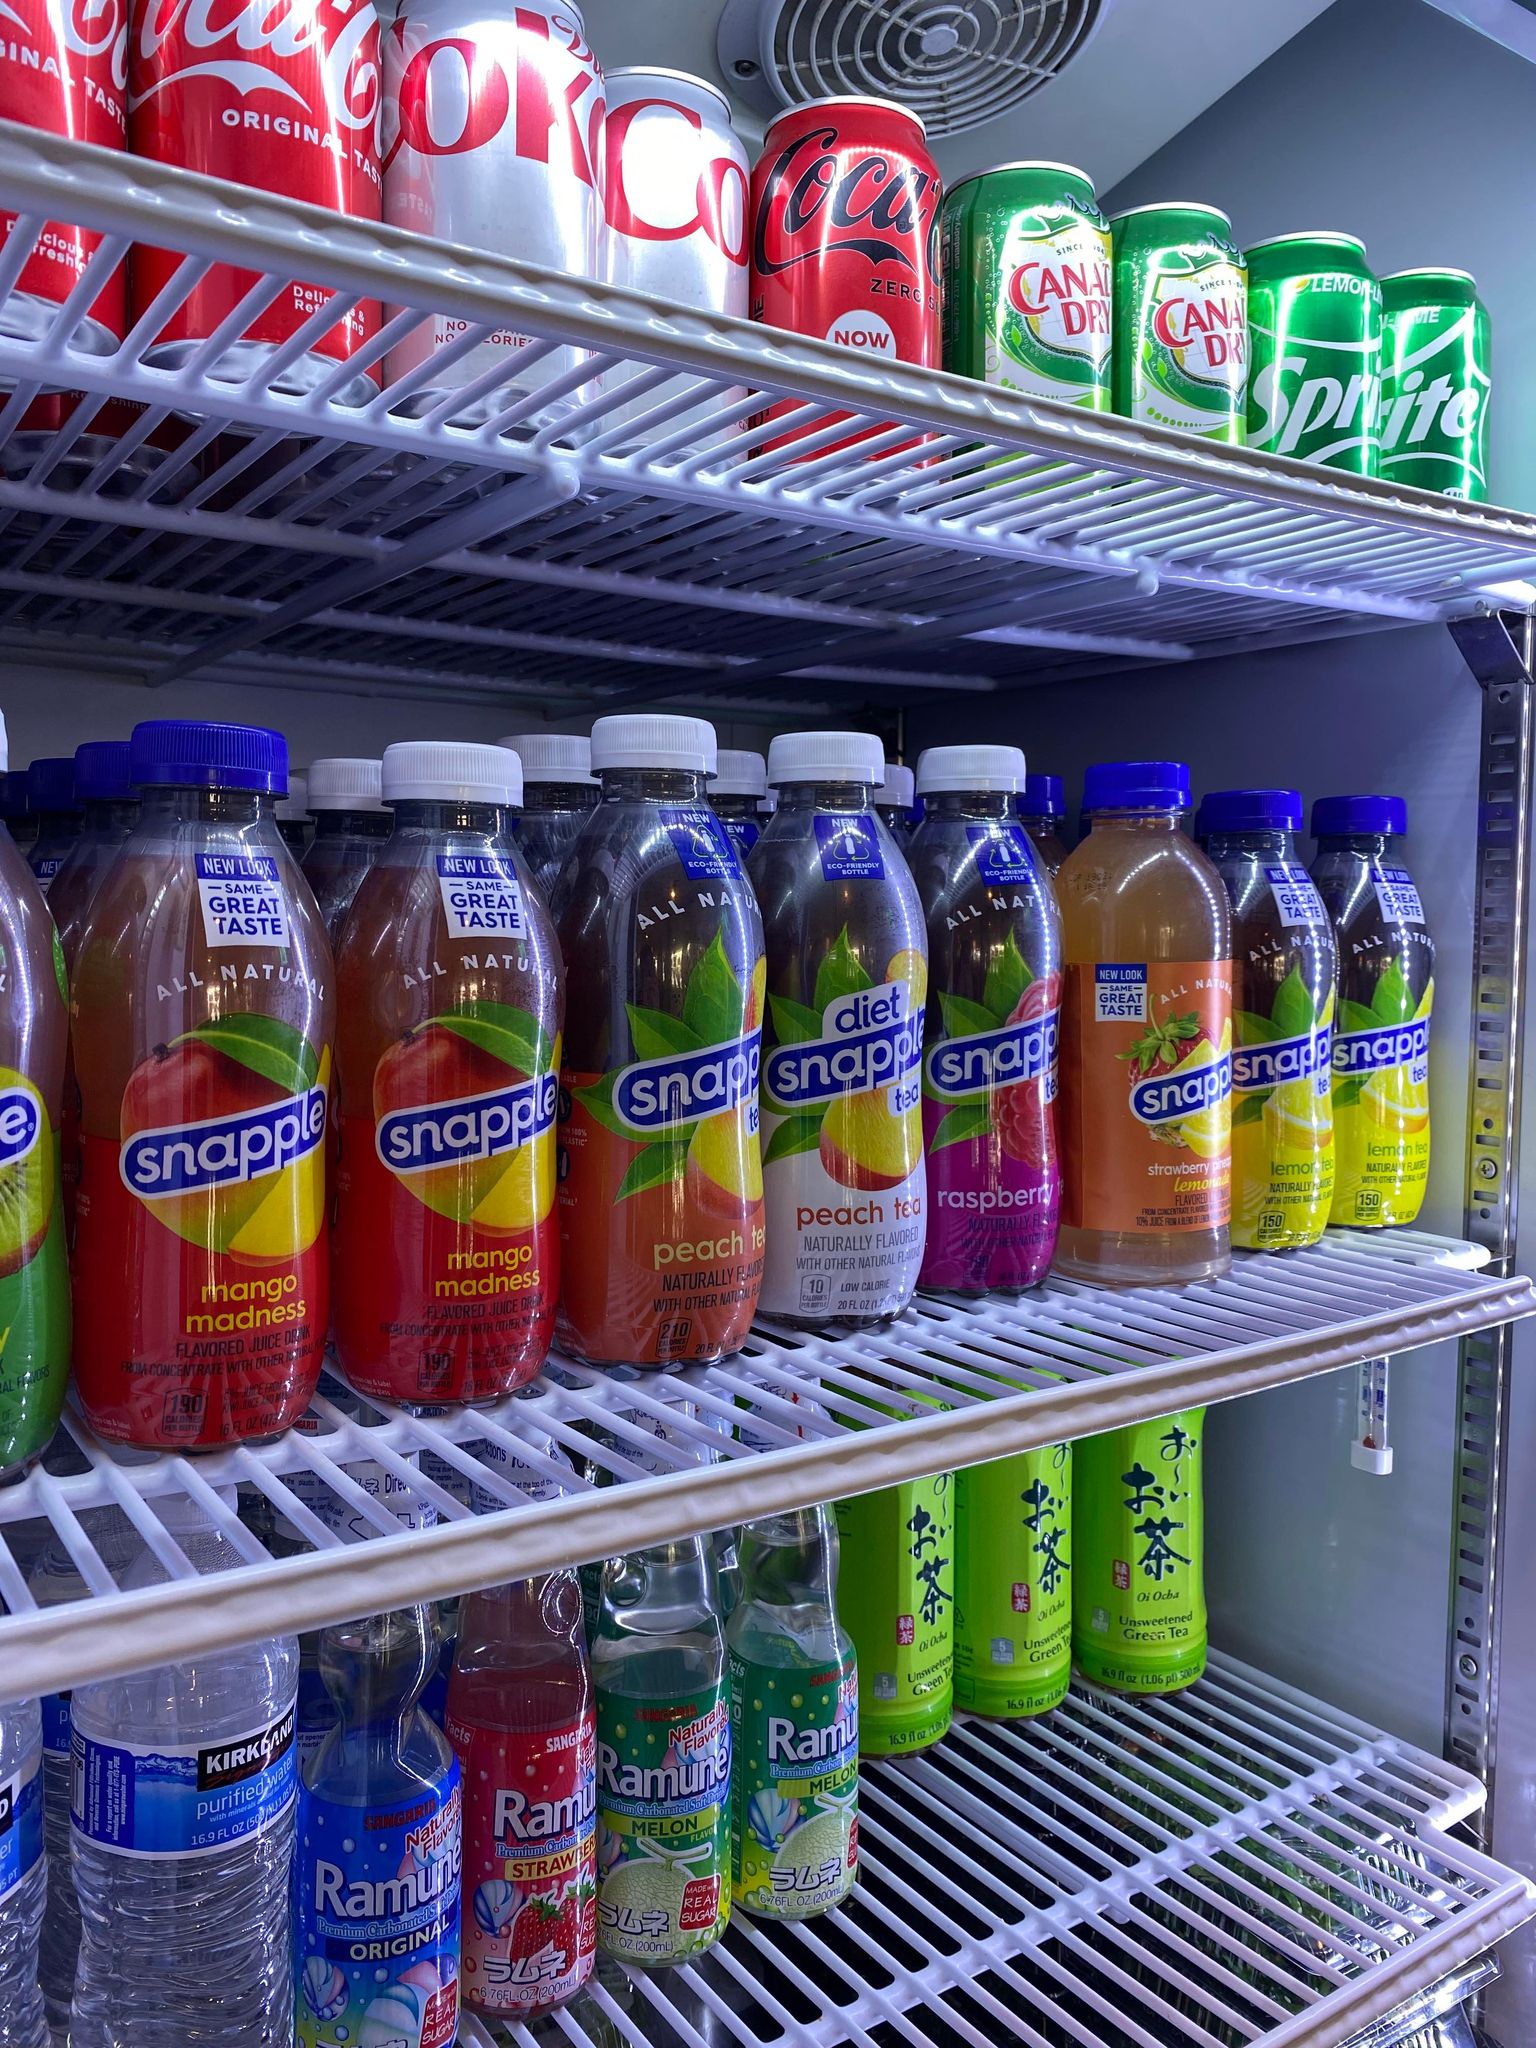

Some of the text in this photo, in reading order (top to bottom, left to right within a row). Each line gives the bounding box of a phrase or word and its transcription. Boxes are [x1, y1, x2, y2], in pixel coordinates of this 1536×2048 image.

[221, 108, 348, 160] ORIGINAL
[871, 278, 923, 304] ZERO
[446, 320, 468, 332] NO
[834, 330, 890, 350] NOW
[682, 813, 710, 824] NEW
[831, 818, 858, 829] NEW
[204, 857, 273, 878] NEW LOOK
[445, 859, 478, 874] NEW
[827, 862, 880, 871] ECO-FRIENDLY
[841, 867, 870, 876] BOTTLE
[984, 868, 1033, 877] ECO-FRIENDLY
[466, 880, 502, 892] SAME
[999, 874, 1026, 882] BOTTLE
[225, 883, 264, 895] SAME
[1383, 892, 1419, 904] GREAT
[209, 897, 281, 915] GREAT
[450, 893, 518, 910] GREAT
[1280, 893, 1317, 906] GREAT
[454, 911, 521, 929] TASTE
[636, 899, 686, 931] ALL
[946, 904, 982, 930] ALL
[1386, 905, 1421, 917] TASTE
[214, 918, 283, 936] TASTE
[1249, 939, 1282, 962] ALL
[1352, 935, 1384, 954] ALL
[402, 953, 558, 991] ALL NATURAL
[1100, 968, 1144, 981] NEW LOOK
[157, 963, 325, 1001] ALL NATURAL
[1109, 984, 1134, 993] SAME
[1099, 993, 1144, 1005] GREAT
[1160, 986, 1188, 1005] ALL
[835, 986, 900, 1033] diet
[1100, 1004, 1143, 1017] TASTE
[895, 1082, 919, 1112] tea
[384, 1076, 556, 1160] snapple
[134, 1096, 325, 1184] snapple
[1148, 1161, 1210, 1176] strawberry
[1269, 1182, 1312, 1193] NATURALLY
[937, 1184, 1054, 1215] raspberry
[1359, 1193, 1379, 1206] 150
[796, 1196, 921, 1232] peach tea
[1262, 1214, 1283, 1228] 150
[803, 1225, 919, 1252] NATURALLY FLAVORED
[447, 1245, 533, 1272] mango
[653, 1229, 744, 1271] peach
[795, 1252, 896, 1271] WITH OTHER NATURAL
[434, 1268, 540, 1298] madness
[662, 1266, 734, 1292] NATURALLY
[809, 1279, 824, 1294] 10
[840, 1278, 890, 1293] LOW CALORIE
[201, 1273, 298, 1305] mango
[427, 1300, 518, 1320] FLAVORED JUICE
[653, 1294, 717, 1313] WITH OTHER
[837, 1300, 870, 1311] 20 FL OZ
[186, 1299, 307, 1334] madness
[660, 1321, 689, 1339] 210
[176, 1333, 281, 1358] FLAVORED JUICE
[150, 1362, 223, 1377] CONCENTRATE
[226, 1359, 253, 1374] WITH
[255, 1353, 284, 1370] OTHER
[172, 1394, 203, 1414] 190
[1136, 1589, 1180, 1603] Oi Ocha
[1049, 1600, 1065, 1616] Ocha
[1119, 1610, 1193, 1628] Unsweetened
[929, 1630, 948, 1644] Ocha
[1122, 1626, 1189, 1641] Green Tea
[1029, 1642, 1062, 1663] Green
[912, 1674, 944, 1696] Green
[1126, 1673, 1137, 1683] oz
[1140, 1675, 1163, 1686] (1.06
[1006, 1696, 1044, 1710] 16.9 fl oz
[669, 1696, 730, 1748] Naturally
[206, 1714, 294, 1775] KIRKLAND
[888, 1730, 926, 1747] 16.9 fl oz
[770, 1763, 813, 1778] Premium
[809, 1765, 857, 1795] MELON
[197, 1775, 266, 1821] purified
[267, 1753, 294, 1789] water
[209, 1810, 227, 1823] with
[364, 1797, 437, 1832] SANGARIA
[636, 1800, 689, 1818] Carbonated
[191, 1822, 245, 1846] 16.9 FL OZ
[631, 1815, 698, 1837] MELON
[495, 1840, 544, 1859] Premium
[769, 1856, 841, 1892] ラムネ
[686, 1884, 706, 1895] MADE
[684, 1894, 717, 1909] REAL
[317, 1906, 430, 1939] Premium Carbonated
[681, 1908, 717, 1924] SUGAR
[349, 1920, 450, 1962] ORIGINAL
[484, 1949, 567, 1986] ラムネ
[425, 2000, 455, 2028] REAL
[422, 2015, 454, 2045] SUGAR
